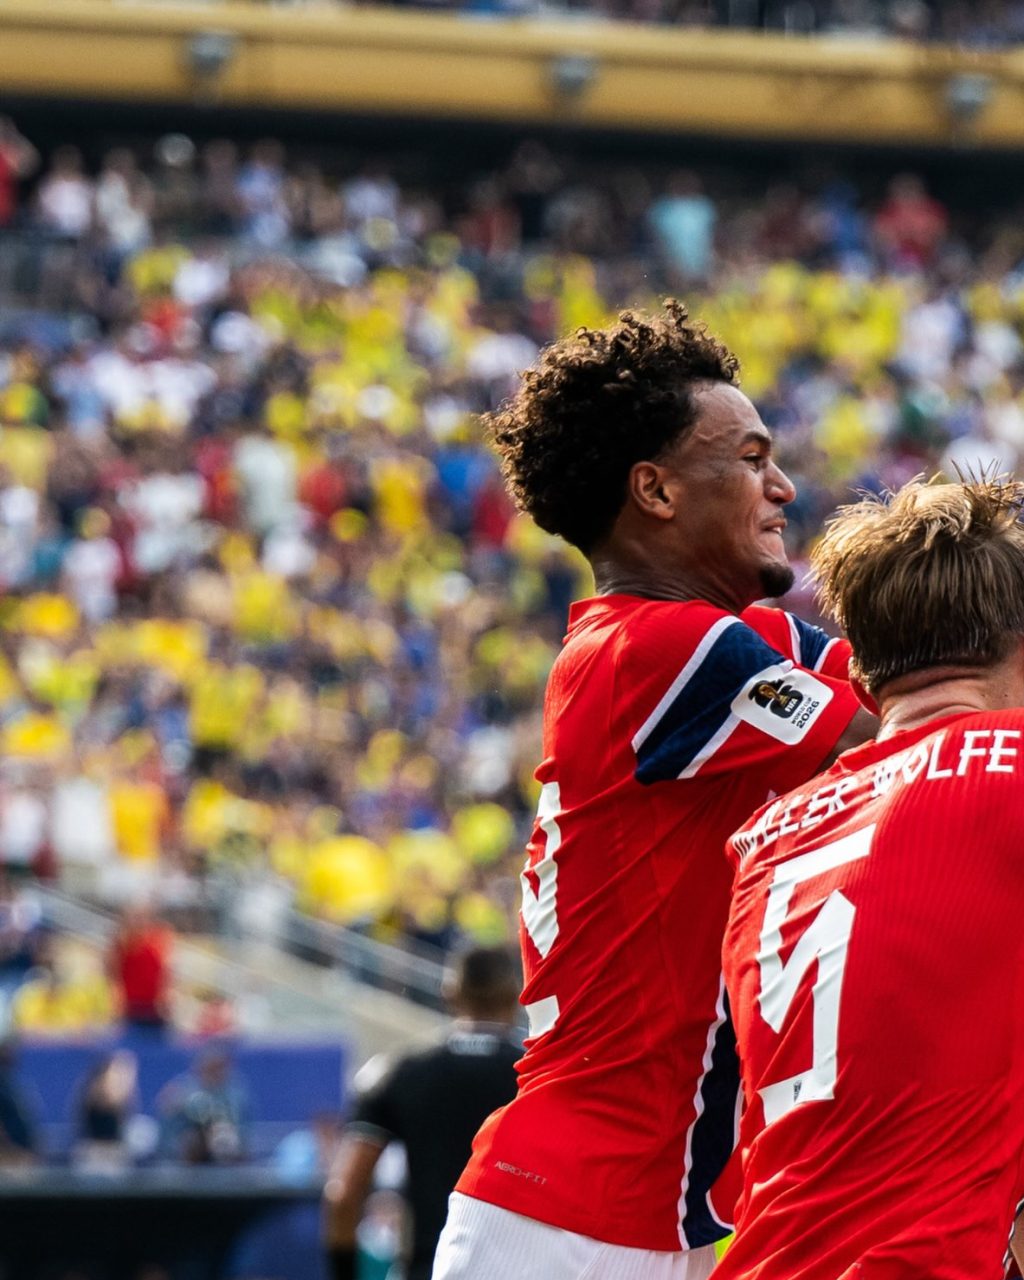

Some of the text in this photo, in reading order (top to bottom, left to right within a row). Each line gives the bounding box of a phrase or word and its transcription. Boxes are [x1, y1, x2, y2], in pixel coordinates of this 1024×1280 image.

[784, 698, 798, 712] FIFA
[796, 701, 820, 729] 2026
[757, 823, 877, 1126] 5
